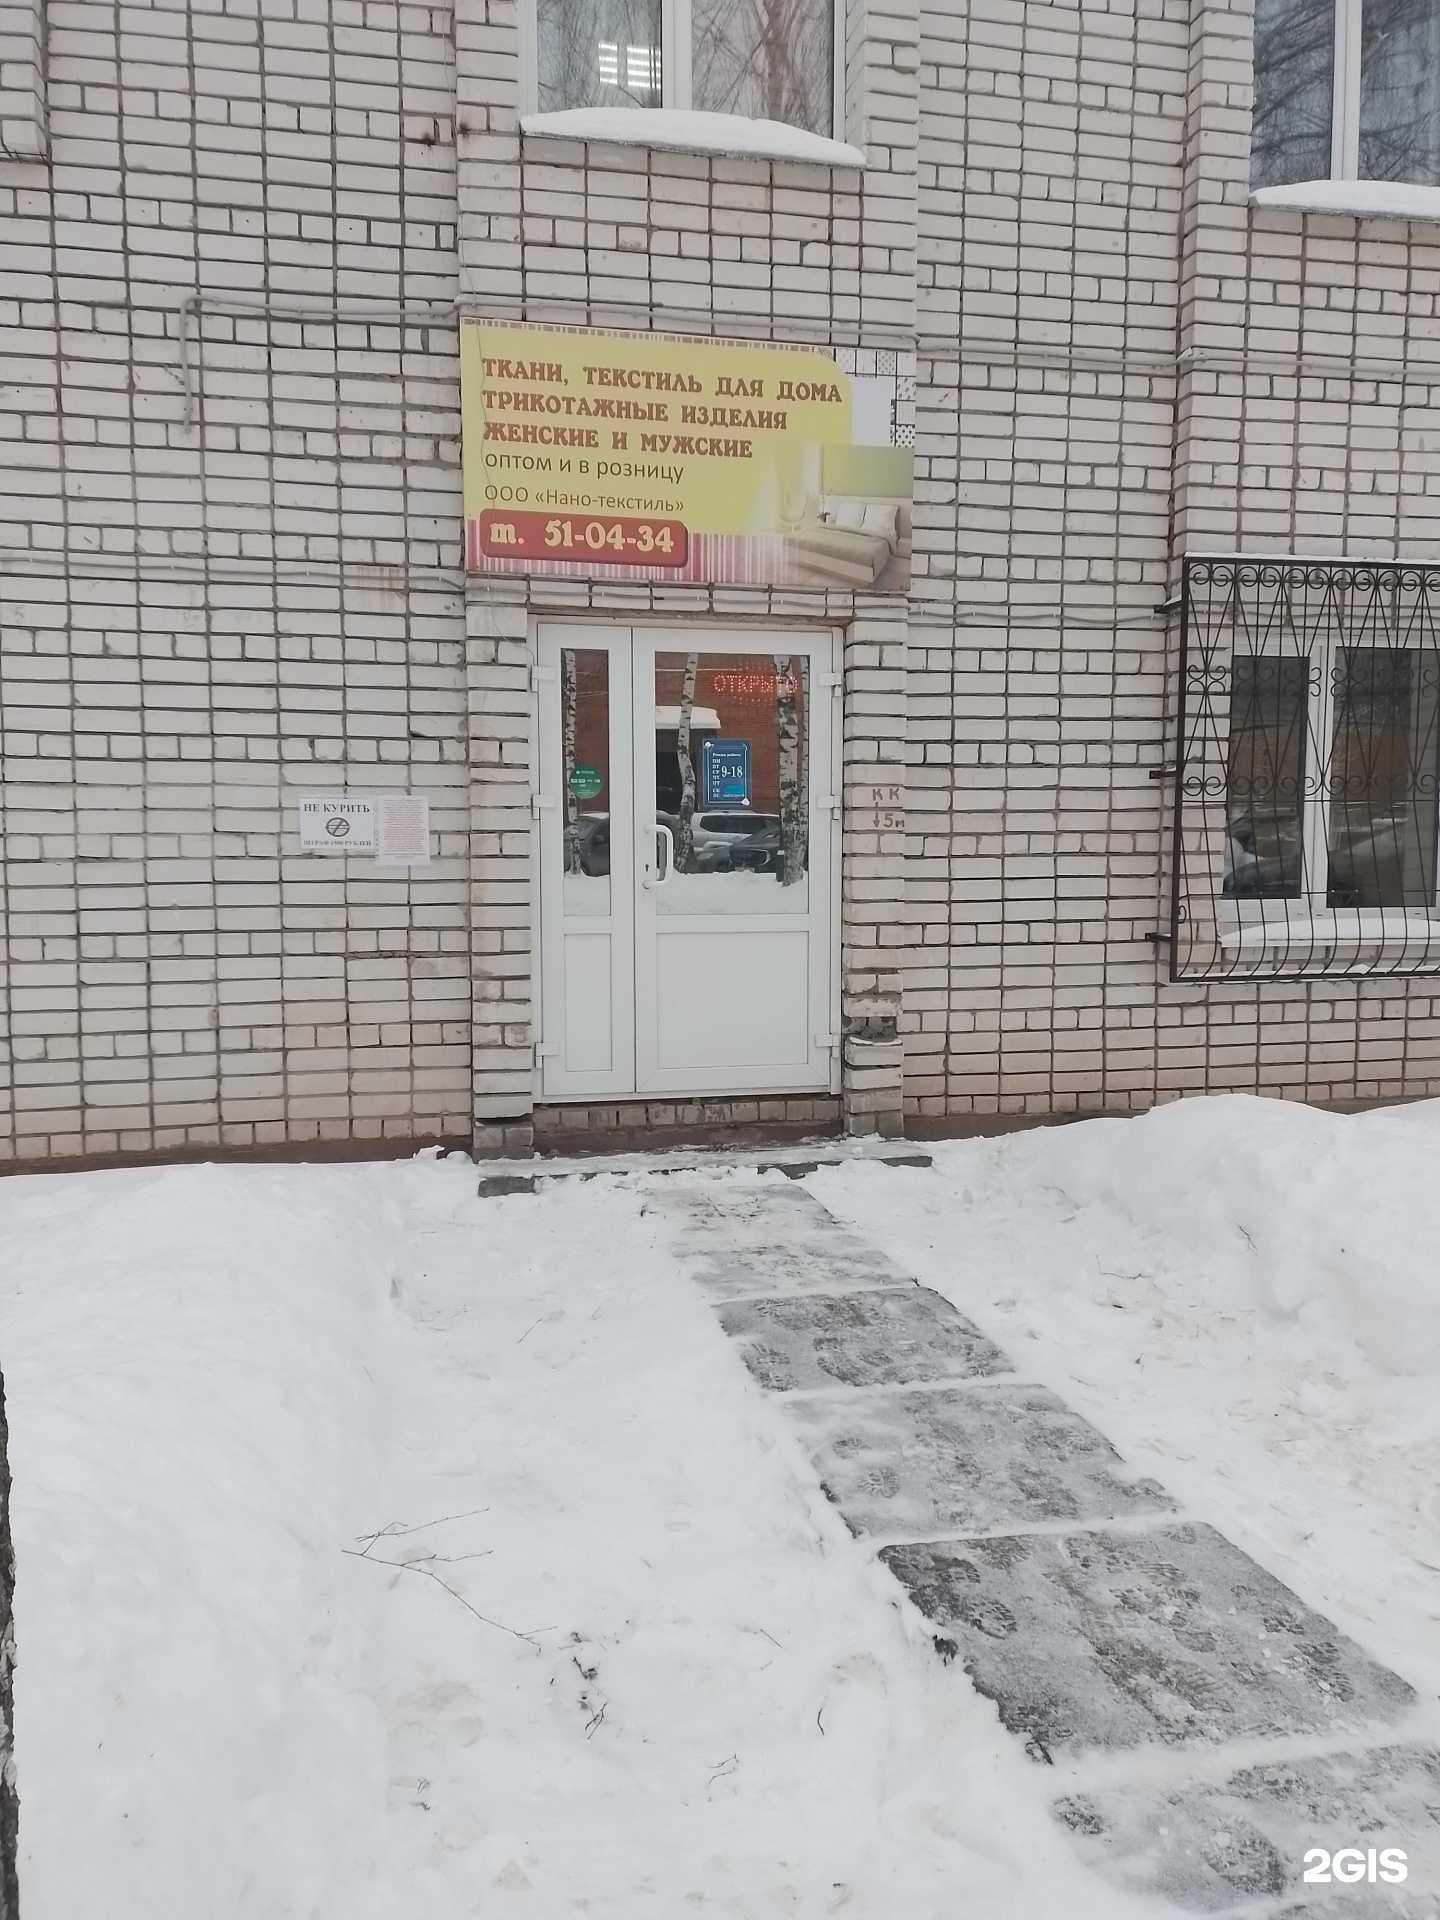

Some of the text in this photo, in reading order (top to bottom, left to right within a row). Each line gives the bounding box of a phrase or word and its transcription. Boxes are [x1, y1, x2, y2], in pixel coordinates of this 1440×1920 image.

[481, 358, 842, 402] ТКАНИ, ТЕКСТИЛЬ ДЛЯ ДОМА
[482, 390, 787, 430] ТРИКОТАЖНЫЕ ИЗДЕЛИЯ
[483, 421, 753, 458] ЖЕНСКИЕ И МУЖСКИЕ
[485, 453, 684, 484] оптом и в розницу
[484, 484, 684, 512] ООО «Нано-текстиль»
[544, 518, 675, 553] 51-04-34
[721, 765, 743, 778] 9-18
[304, 803, 370, 813] НЕ КУРИТЬ
